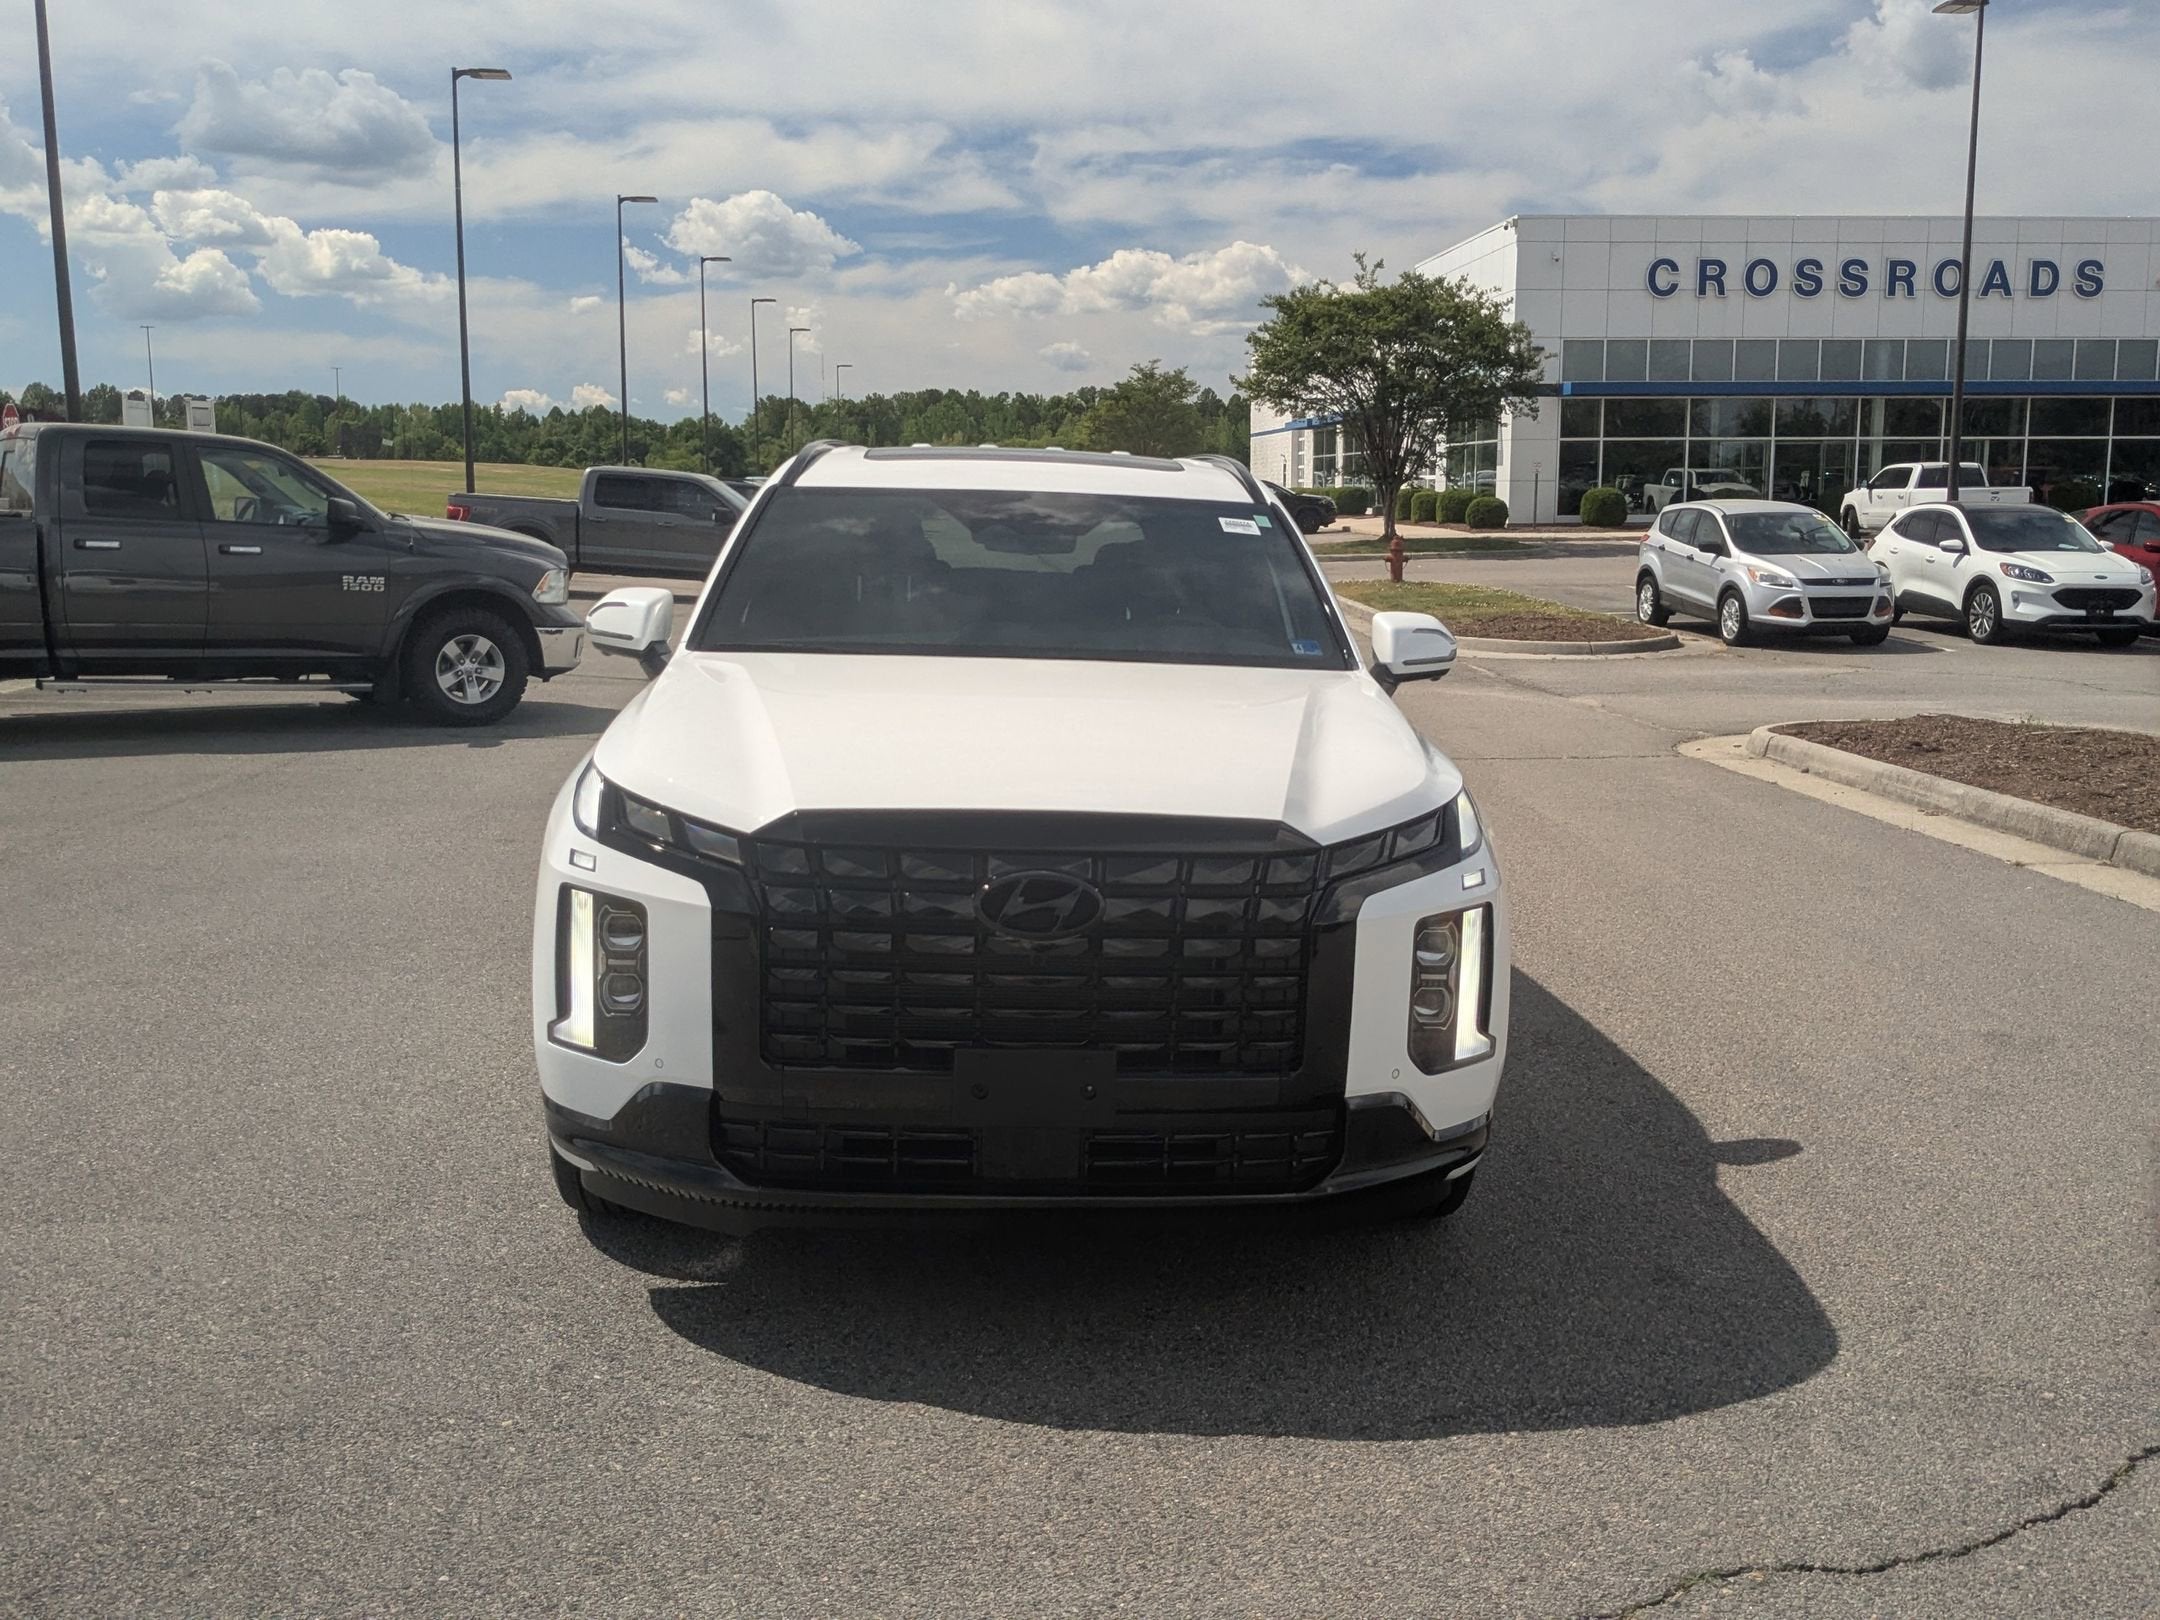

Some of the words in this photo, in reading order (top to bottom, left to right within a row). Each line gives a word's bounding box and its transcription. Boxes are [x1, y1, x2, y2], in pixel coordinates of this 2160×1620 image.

[1646, 258, 2106, 299] CROSSROADS
[342, 575, 385, 584] RAM
[342, 583, 385, 592] 1500
